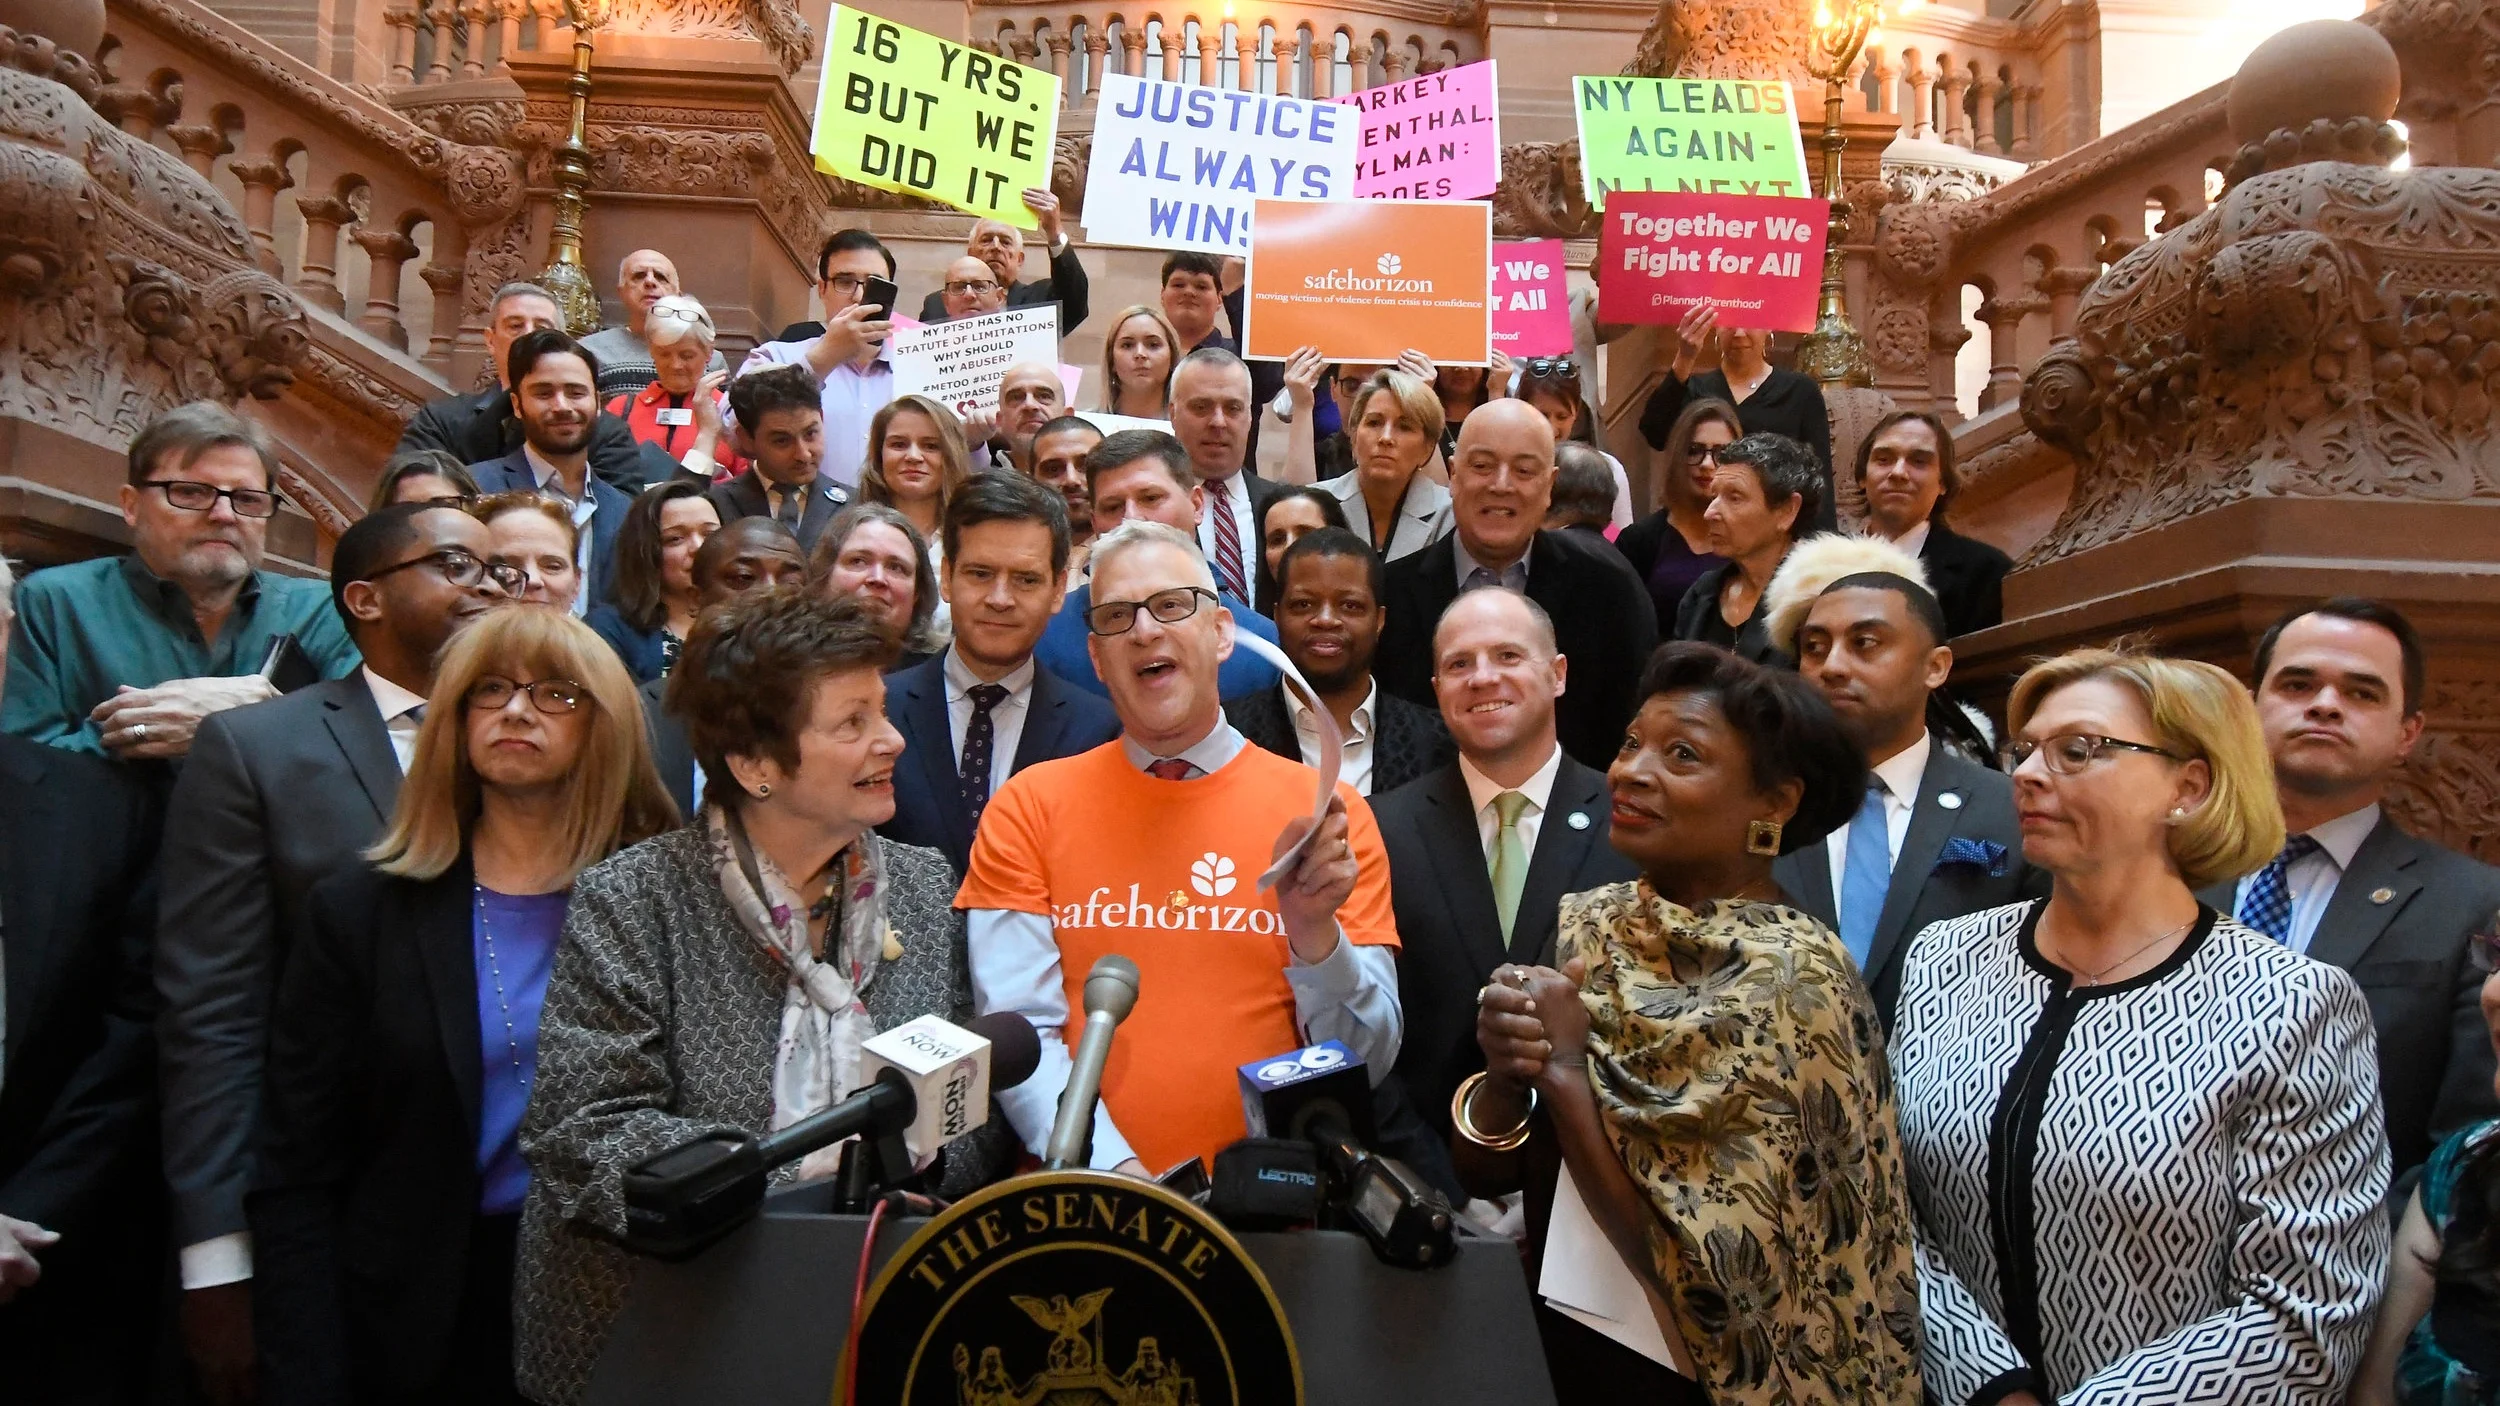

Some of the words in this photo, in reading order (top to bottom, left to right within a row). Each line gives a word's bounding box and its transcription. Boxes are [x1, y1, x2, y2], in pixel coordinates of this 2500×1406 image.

[853, 16, 901, 64] 16
[938, 41, 1039, 112] YRS.
[1582, 79, 1634, 112] NY
[1654, 81, 1788, 115] LEADS
[844, 71, 939, 132] BUT
[976, 110, 1035, 162] WE
[1115, 81, 1337, 144] JUSTICE
[1626, 125, 1776, 163] AGAIN-
[860, 133, 937, 190] DID
[965, 166, 1009, 210] IT
[1119, 137, 1331, 198] ALWAYS
[1619, 212, 1758, 243] Together
[1765, 216, 1813, 243] We
[1504, 260, 1550, 281] We
[1623, 245, 1702, 278] Fight
[1707, 247, 1754, 275] for
[1757, 252, 1802, 278] All
[1304, 268, 1434, 293] safehorizon
[1255, 292, 1289, 304] moving
[1290, 293, 1323, 303] victims
[1324, 294, 1336, 303] of
[1335, 294, 1373, 305] violence
[1374, 296, 1396, 306] from
[1397, 297, 1420, 306] crisis
[1422, 298, 1433, 307] to
[1434, 298, 1483, 308] confidence
[1508, 288, 1547, 312] All
[1662, 295, 1704, 307] Planned
[1703, 296, 1763, 310] Parenthood
[897, 340, 949, 356] STATUTE
[953, 335, 968, 346] OF
[972, 320, 1055, 342] LIMITATIONS
[922, 326, 943, 338] MY
[943, 321, 974, 334] PTSD
[977, 315, 1002, 328] HAS
[1005, 312, 1024, 323] NO
[933, 349, 962, 363] WHY
[964, 340, 1014, 357] SHOULD
[938, 365, 960, 375] MY
[959, 353, 1013, 371] ABUSER?
[922, 379, 969, 392] #METOO
[973, 370, 1010, 384] #KIDS
[941, 384, 1001, 401] #NYPASSC
[901, 1035, 955, 1059] NOW
[1299, 1044, 1345, 1069] 6
[944, 1078, 960, 1136] NOW
[909, 1208, 1012, 1292] THE
[1022, 1191, 1219, 1281] SENATE
